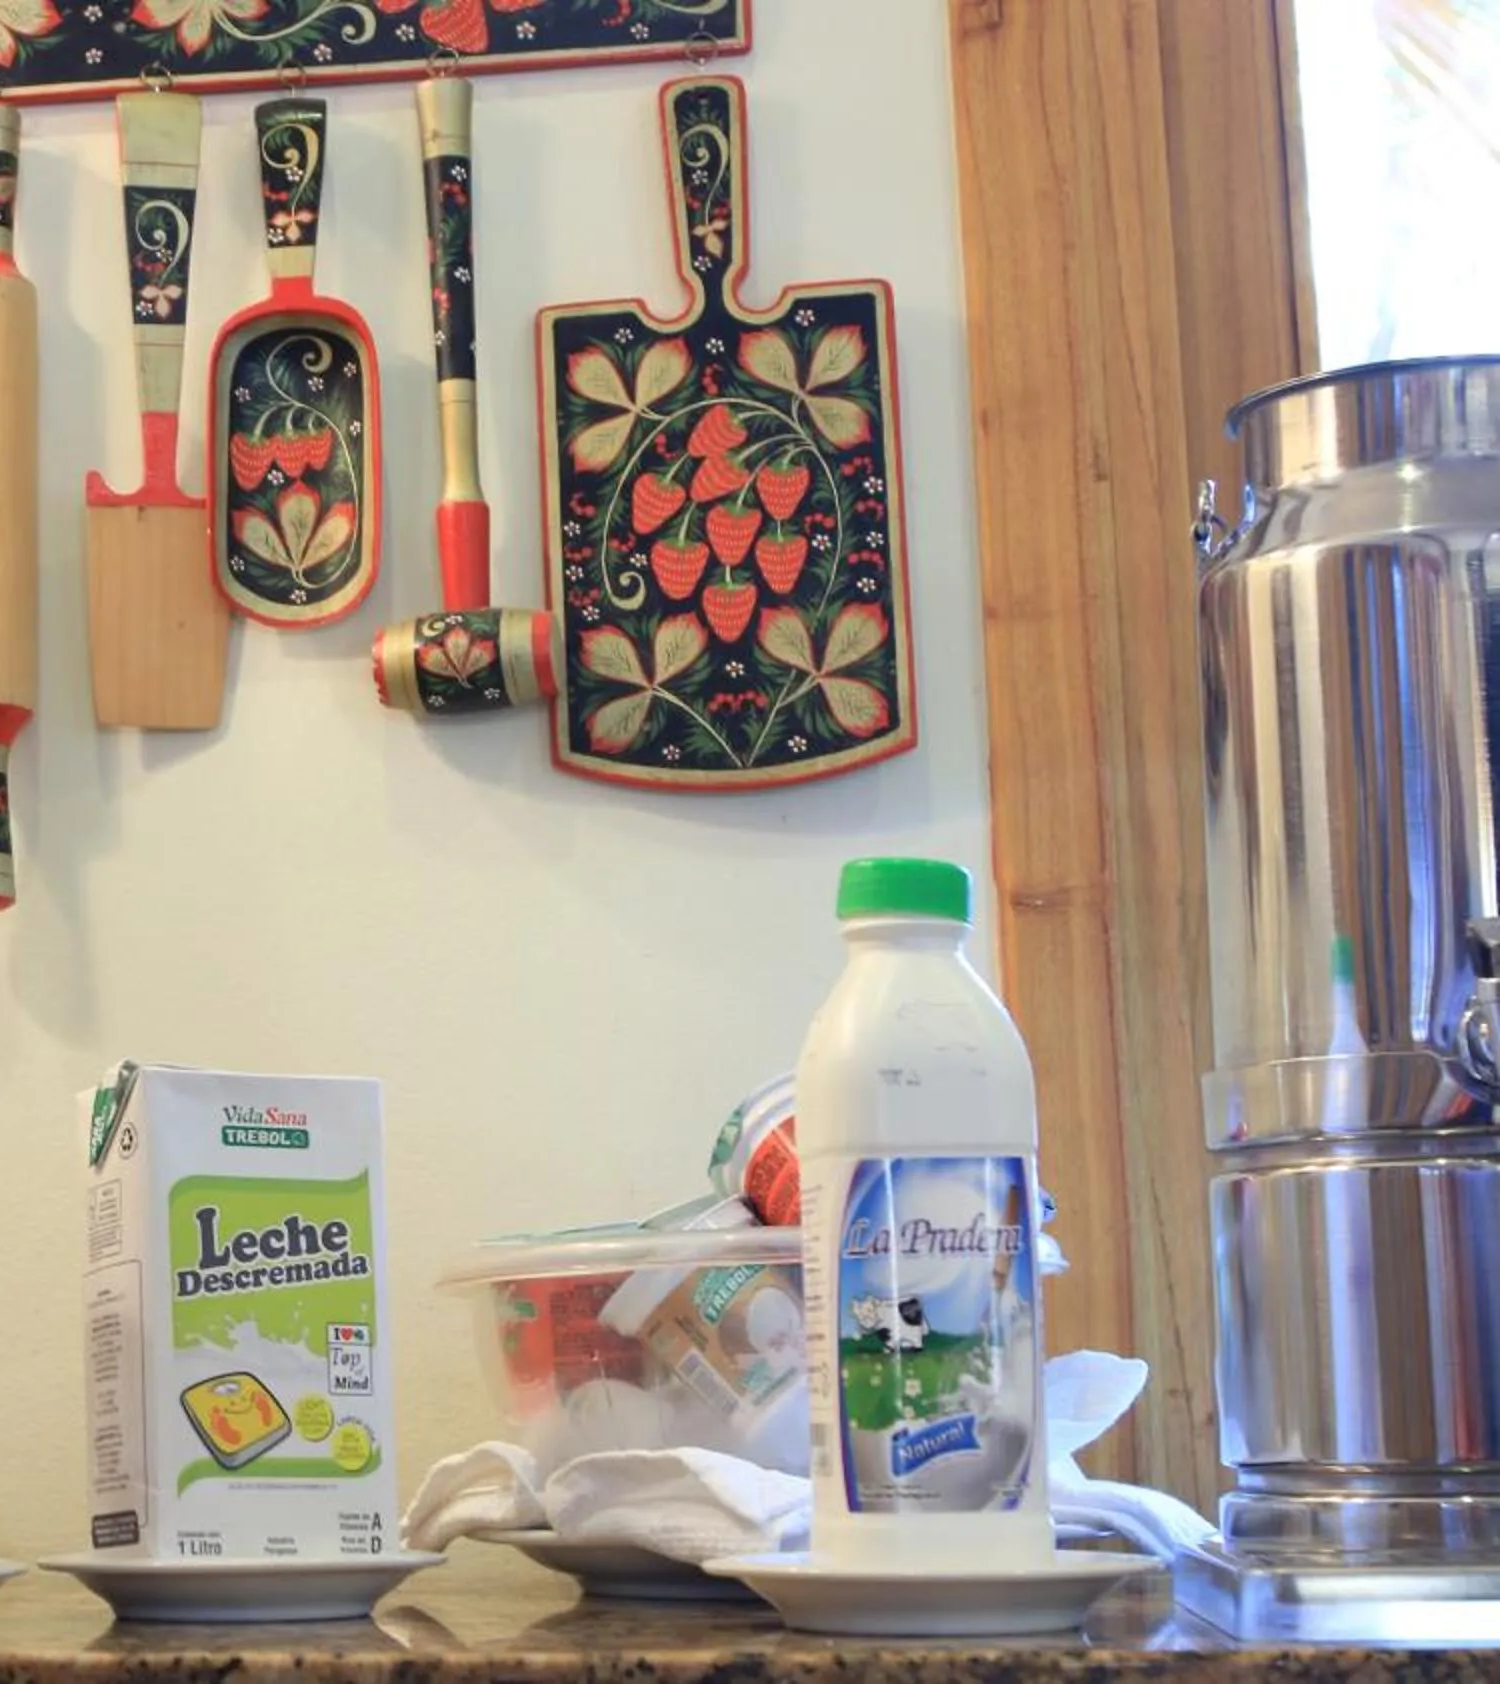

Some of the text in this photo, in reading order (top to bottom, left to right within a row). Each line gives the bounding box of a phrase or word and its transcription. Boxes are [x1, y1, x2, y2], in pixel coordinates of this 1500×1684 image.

[225, 1128, 291, 1145] TREBOL
[195, 1206, 349, 1270] Leche
[844, 1216, 891, 1257] La
[176, 1250, 370, 1297] Descremada
[331, 1346, 362, 1371] Top
[334, 1375, 369, 1391] Mind
[899, 1420, 967, 1461] Natural
[371, 1512, 383, 1532] A
[177, 1539, 223, 1556] 1 Litro
[370, 1535, 382, 1554] D
